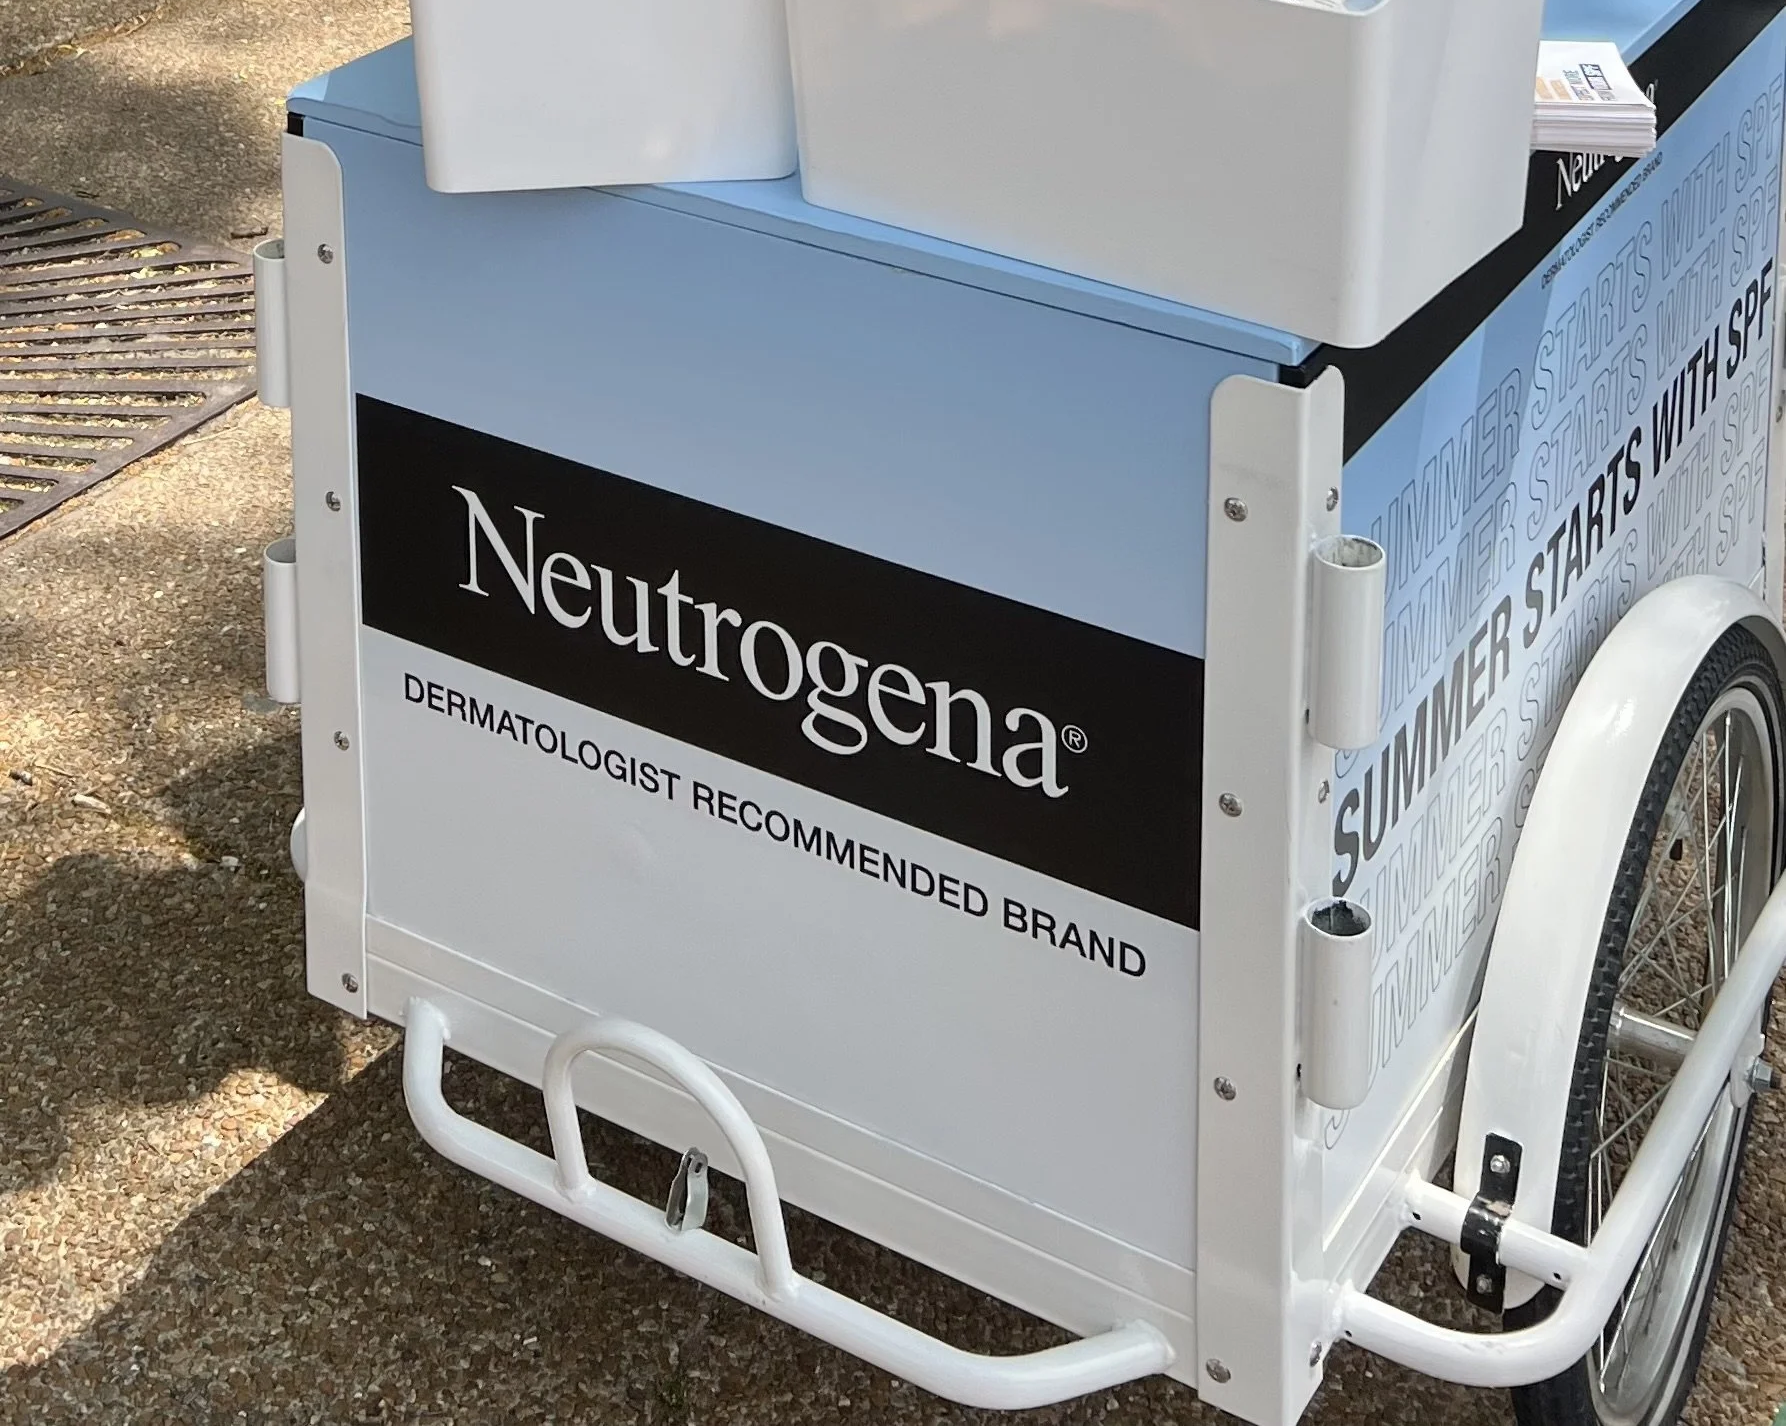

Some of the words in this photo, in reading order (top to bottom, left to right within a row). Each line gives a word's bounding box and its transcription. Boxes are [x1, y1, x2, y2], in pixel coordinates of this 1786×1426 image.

[1370, 367, 1521, 609] UMMER
[1531, 220, 1653, 431] STARTS
[1661, 130, 1731, 281] WITH
[1734, 72, 1783, 194] SPF
[1527, 323, 1648, 542] STARTS
[1656, 226, 1726, 381] WITH
[1730, 163, 1778, 288] SPF
[1715, 435, 1766, 567] SPF
[1332, 594, 1512, 898] SUMMER
[1522, 426, 1642, 650] STARTS
[1652, 323, 1720, 479] WITH
[1726, 256, 1773, 380] SPF
[1360, 708, 1508, 974] UMMER
[1516, 527, 1638, 762] STARTS
[1646, 419, 1716, 582] WITH
[1720, 347, 1770, 475] SPF
[404, 672, 681, 801] DERMATOLOGIST
[692, 780, 989, 918] RECOMMENDED
[1002, 896, 1147, 978] BRAND
